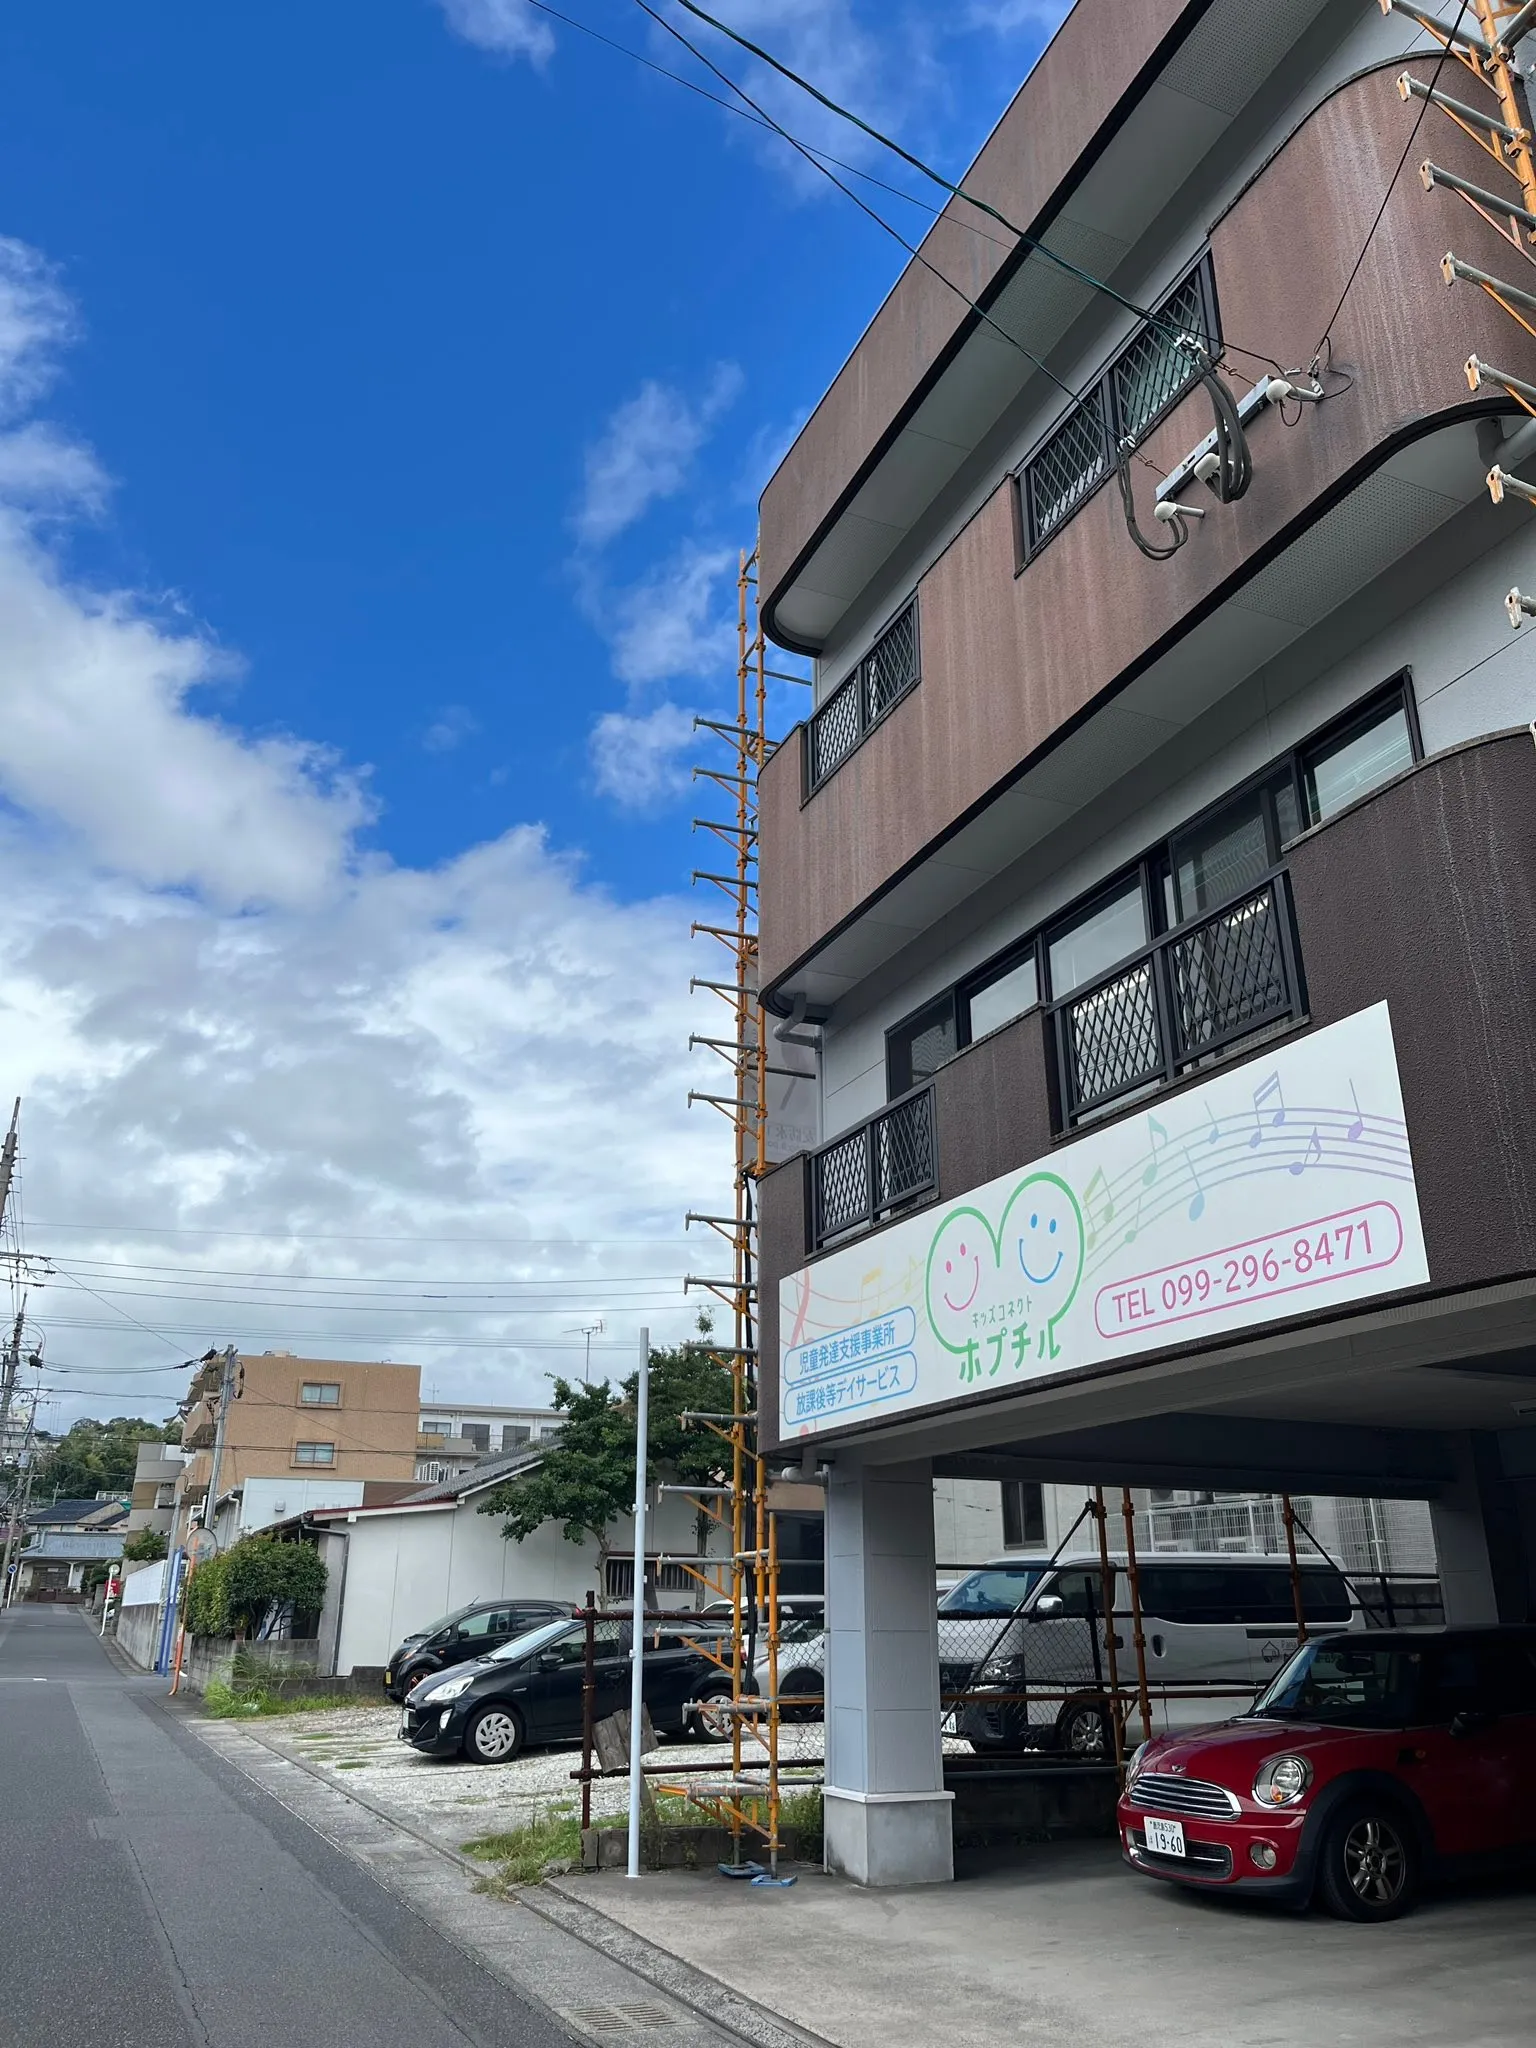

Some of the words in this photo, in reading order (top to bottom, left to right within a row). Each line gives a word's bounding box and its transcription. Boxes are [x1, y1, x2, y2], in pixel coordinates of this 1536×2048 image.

[1112, 1287, 1155, 1323] TEL
[1161, 1219, 1373, 1311] 099-296-8471
[972, 1295, 1033, 1329] キッズコネクト
[799, 1319, 896, 1376] 児童発達支援事業所
[958, 1320, 1062, 1384] ホプチル
[795, 1365, 901, 1416] 放課後等デイサービス
